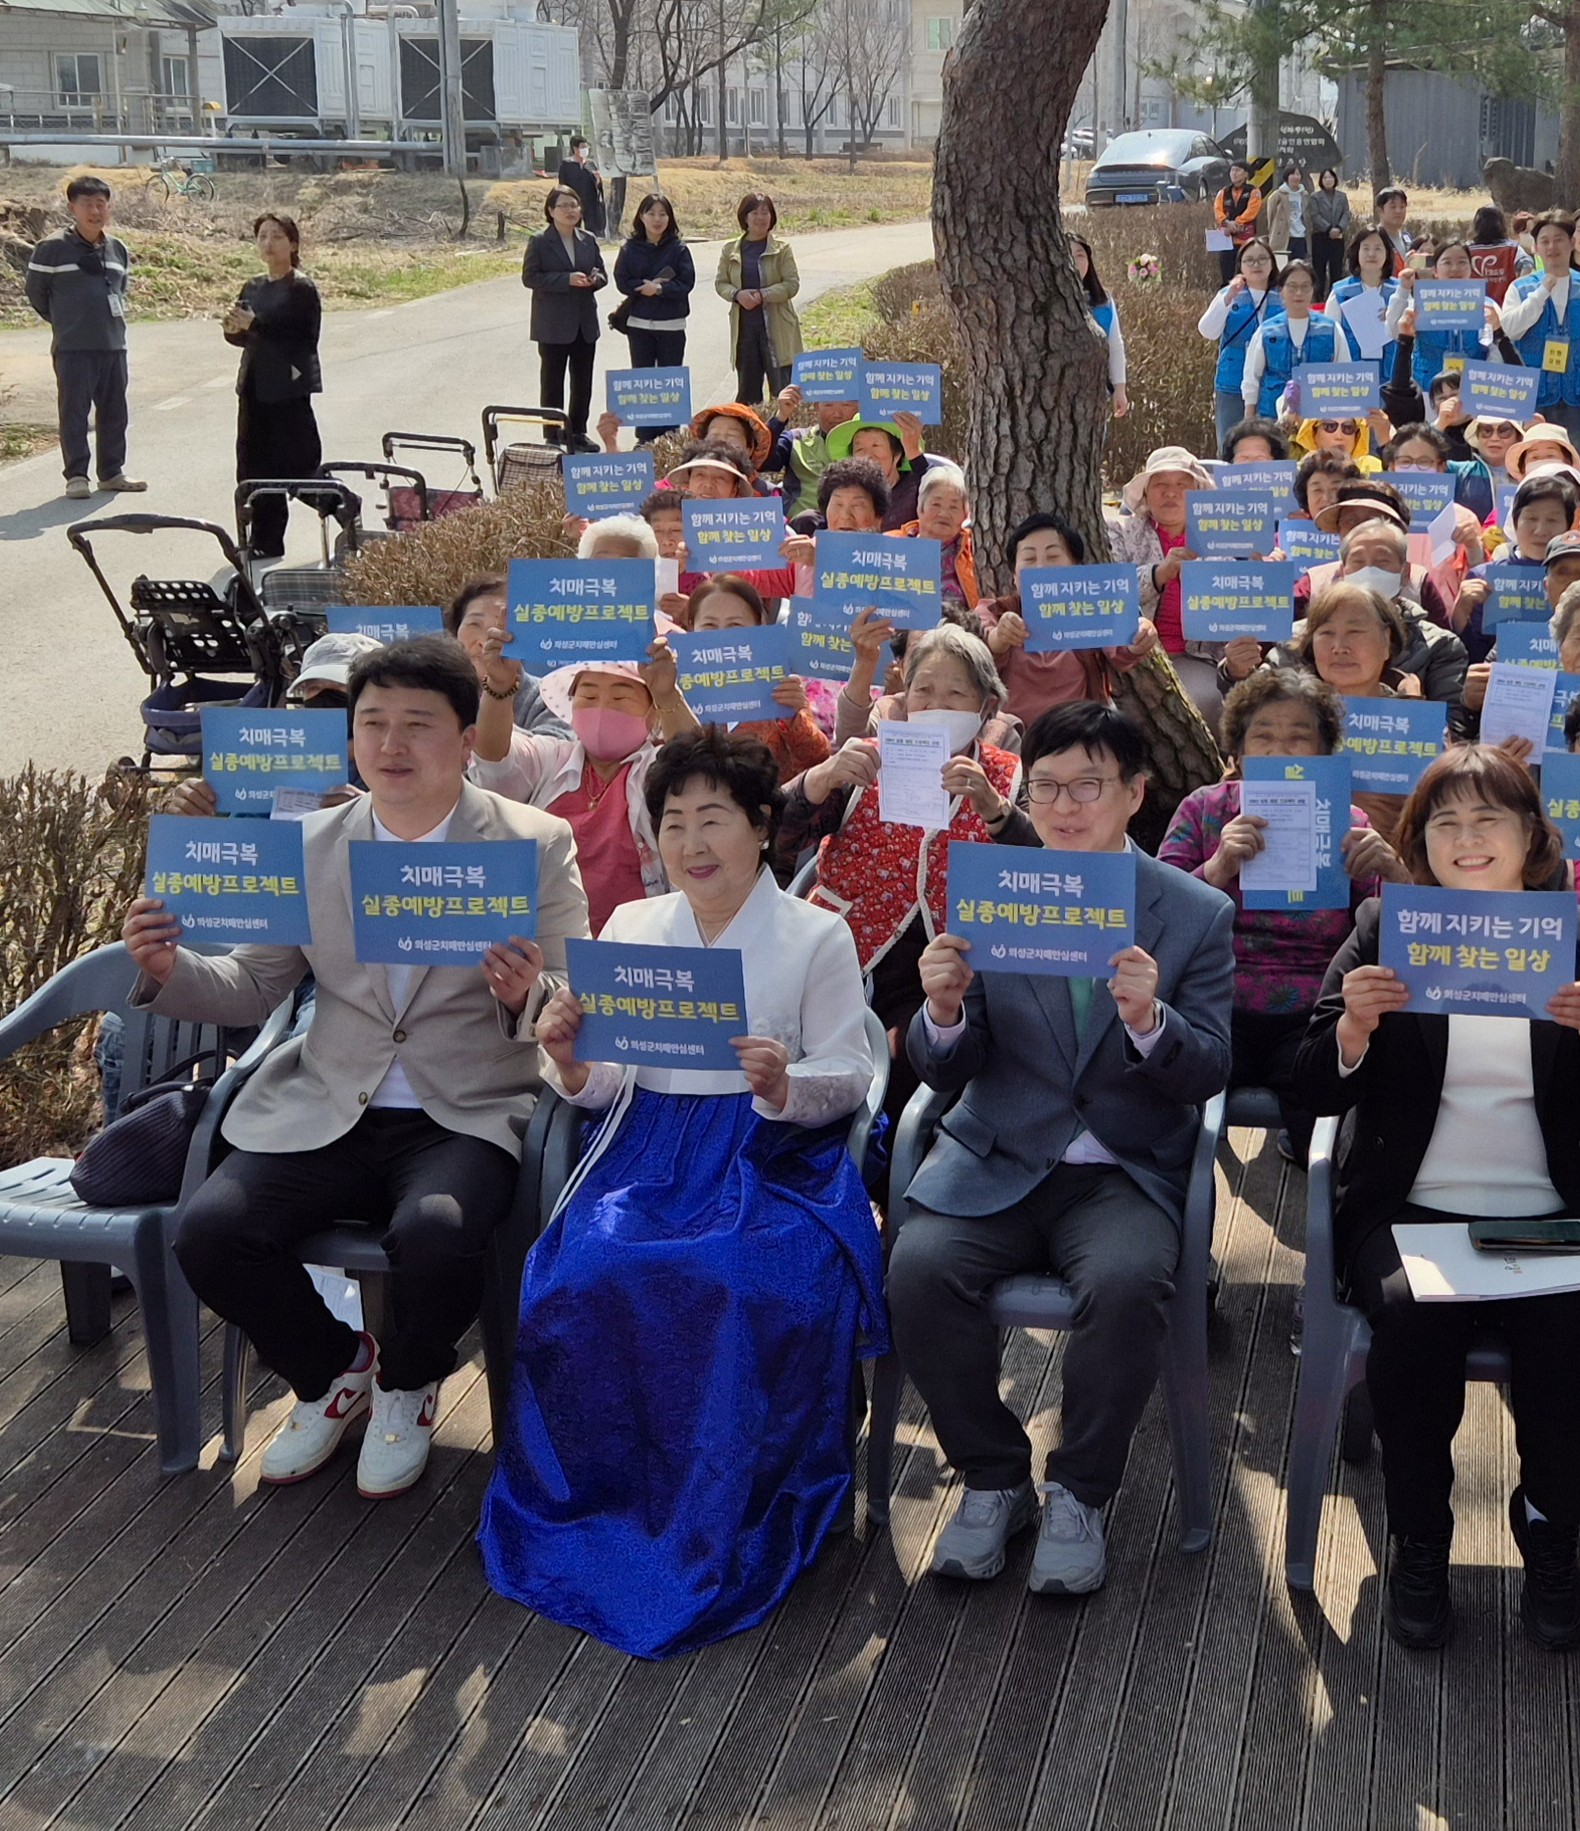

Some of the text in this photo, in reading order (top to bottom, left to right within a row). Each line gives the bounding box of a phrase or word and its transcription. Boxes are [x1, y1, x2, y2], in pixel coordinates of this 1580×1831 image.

[613, 378, 683, 391] 함께 지키는 기억
[866, 372, 934, 386] 함께 지키는 기억
[571, 463, 647, 479] 함께 지키는 기억
[1222, 472, 1292, 487] 함께 지키는 기억
[1398, 483, 1448, 496] 지키는 기억
[1193, 503, 1267, 515] 함께 지키는 기억
[691, 511, 775, 527] 함께 지키는 기억
[1198, 519, 1263, 531] 함께 찾는 일상
[698, 529, 771, 544] 함께 찾는 일상
[1286, 531, 1340, 546] 함께 지키는
[852, 550, 907, 571] 치매극복
[1289, 545, 1312, 559] 함께
[550, 578, 617, 597] 치매극복
[821, 570, 936, 595] 실종예방프로젝트
[1031, 579, 1129, 598] 함께 지키는 기억
[1212, 576, 1264, 590] 치매극복
[1494, 578, 1517, 591] 함께
[1039, 599, 1124, 618] 함께 찾는 일상
[1187, 596, 1289, 610] 실종예방프로젝트
[1499, 595, 1521, 608] 함께
[514, 604, 649, 623] 실종예방프로젝트
[802, 632, 853, 652] 함께 찾는
[692, 645, 752, 664] 치매극복
[679, 665, 786, 691] 종예방프로젝트
[1349, 713, 1409, 734] 치매극복
[240, 728, 305, 747] 치매극복
[210, 753, 342, 772] 실종예방프로젝트
[1316, 798, 1332, 869] 치매극복
[185, 841, 258, 865] 치매극복
[152, 871, 299, 896] 실종예방프로젝트
[401, 866, 486, 888] 치매극복
[999, 870, 1084, 898] 치매극복
[362, 895, 529, 918] 실종예방프로젝트
[957, 899, 1127, 929] 실종예방프로젝트
[197, 918, 268, 929] 의성군치매안심센터
[1398, 909, 1562, 940] 함께 지키는 기억
[415, 940, 493, 953] 의성군치매안심센터
[1009, 948, 1087, 962] 의성군치매안심센터
[1408, 943, 1550, 972] 함께 찾는 일상
[615, 966, 694, 992] 치매극복
[1443, 989, 1528, 1004] 의성군치매안심센터
[579, 991, 739, 1023] 실종예방프로젝트
[631, 1040, 704, 1055] 의성군치매안심센터
